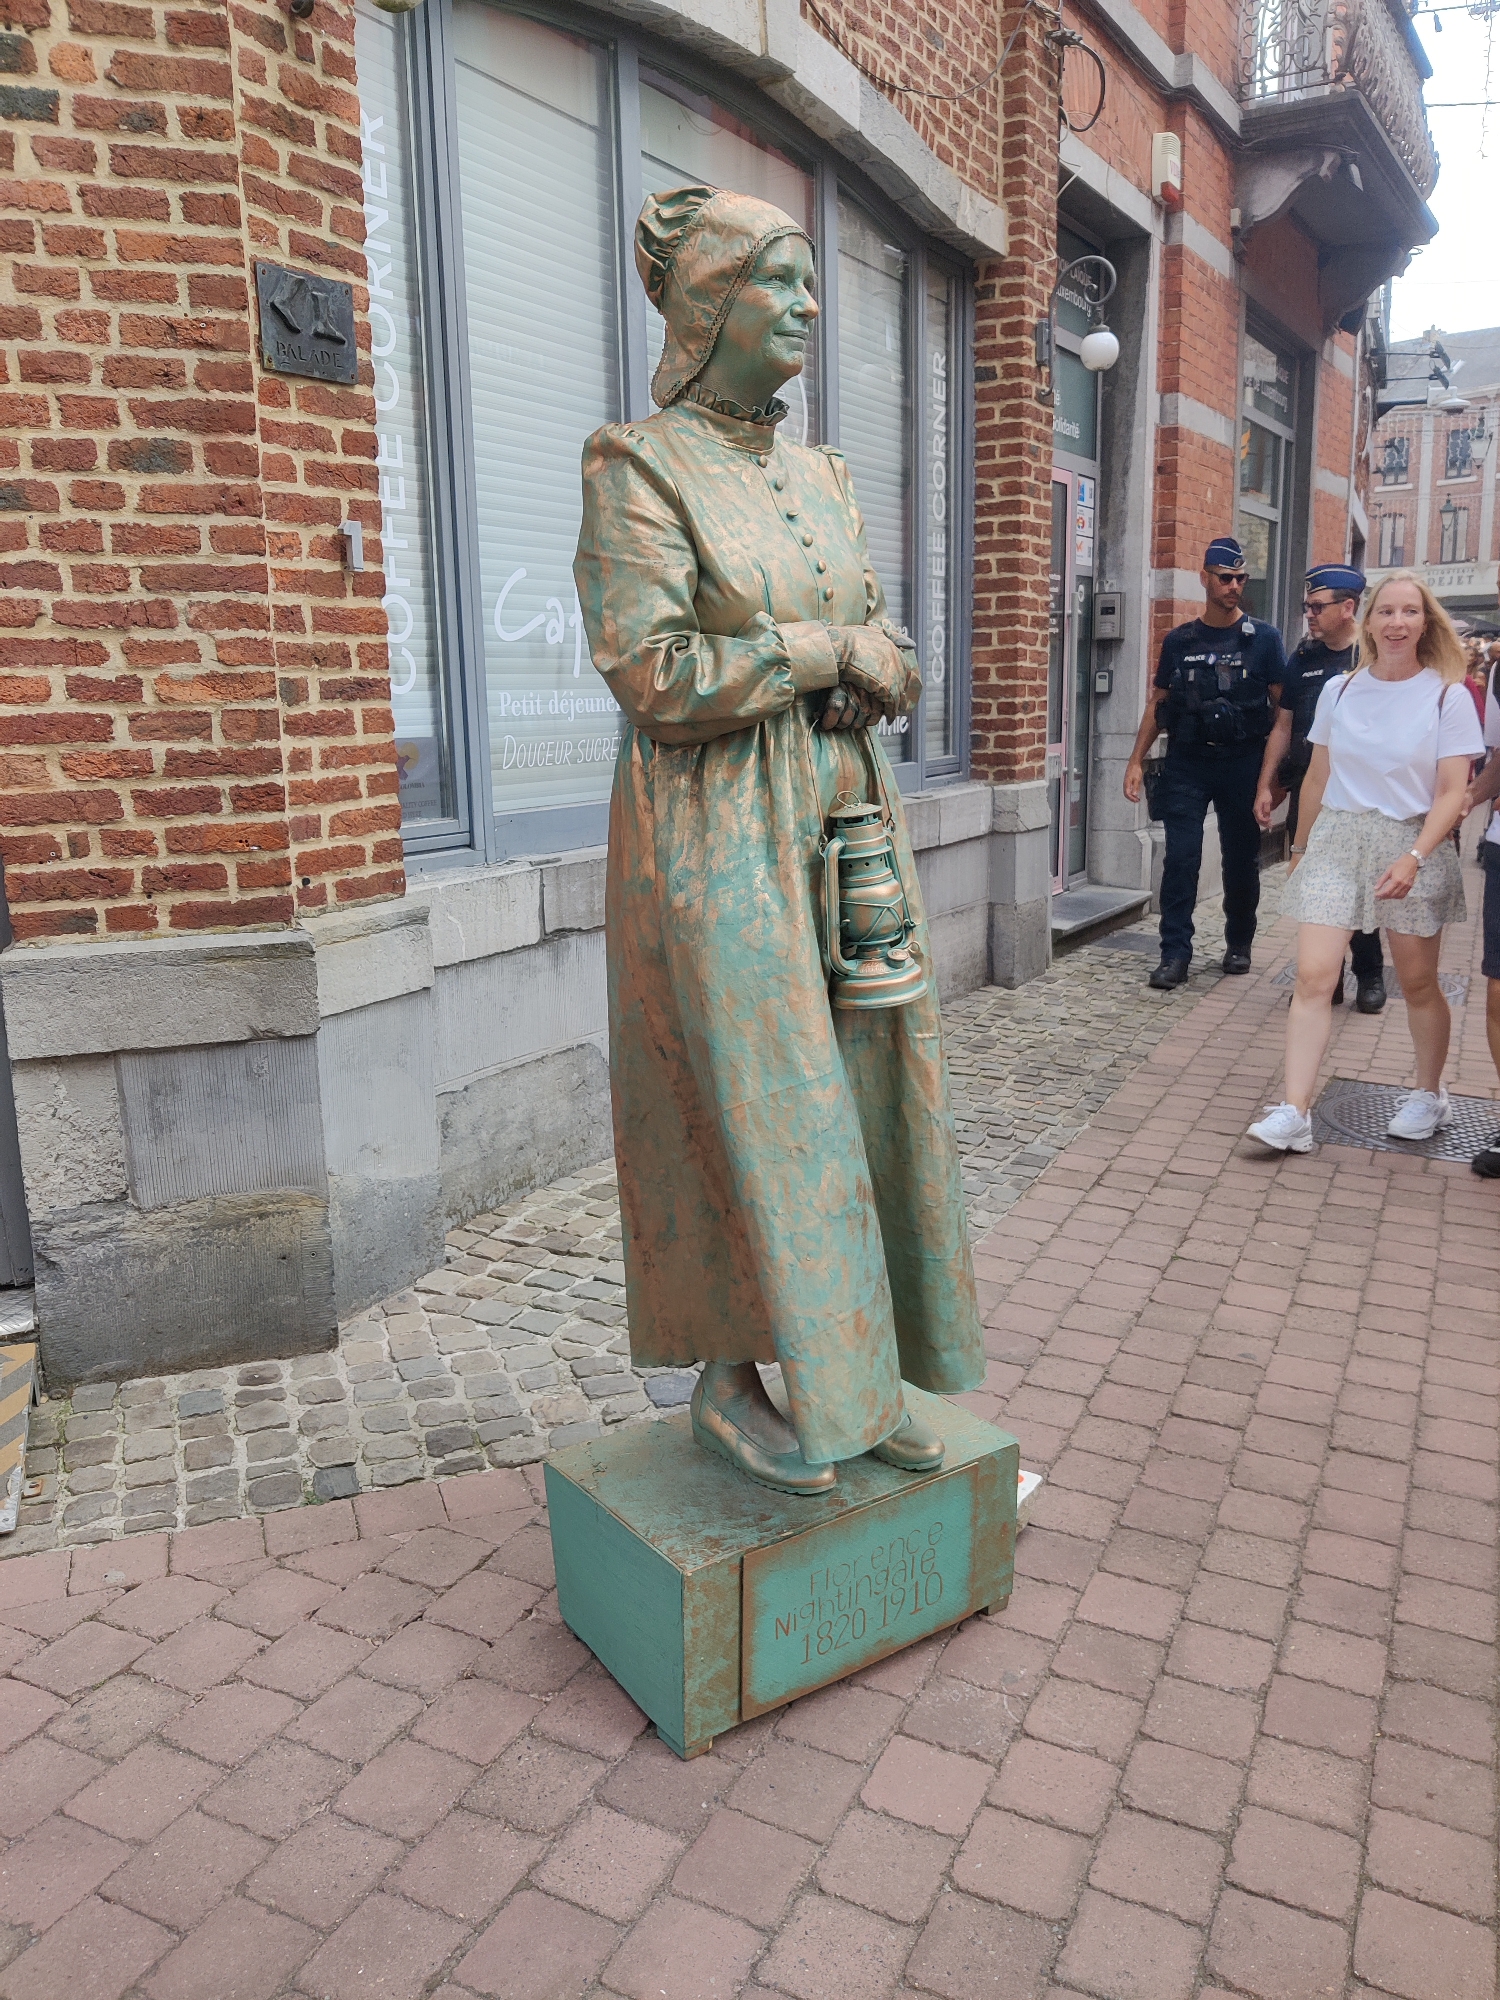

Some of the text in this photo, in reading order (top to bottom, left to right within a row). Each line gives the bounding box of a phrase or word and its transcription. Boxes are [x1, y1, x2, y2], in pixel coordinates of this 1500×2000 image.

[1056, 285, 1091, 317] uxembourg
[275, 340, 344, 369] BALADE
[359, 108, 417, 695] COFFEE CORNER
[1053, 413, 1080, 439] olidarité
[931, 351, 947, 684] COFFEE CORNER
[338, 521, 363, 572] 1
[494, 567, 582, 679] Caf
[1302, 669, 1324, 678] POLICE
[499, 692, 543, 717] Petit
[502, 730, 621, 769] DOUCEUR SUCRÉ
[810, 1521, 943, 1596] Florence
[775, 1547, 937, 1640] Nightingale
